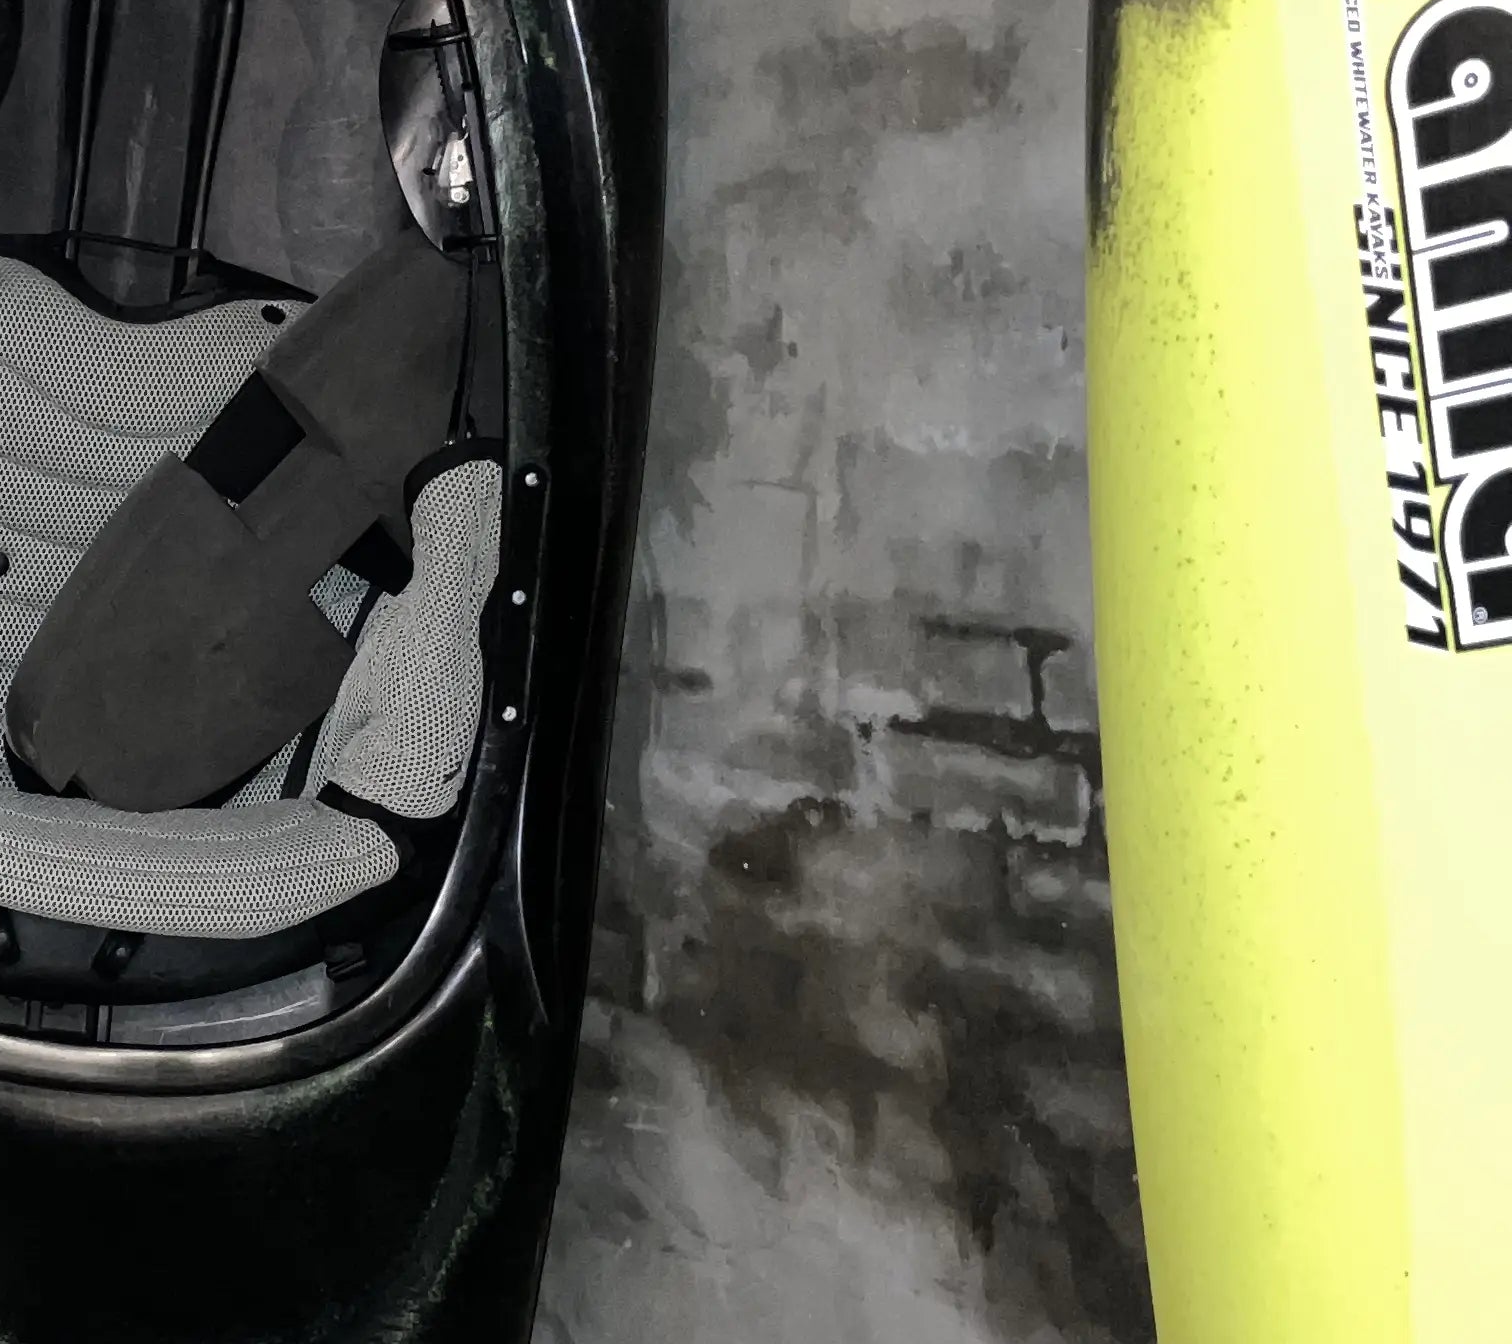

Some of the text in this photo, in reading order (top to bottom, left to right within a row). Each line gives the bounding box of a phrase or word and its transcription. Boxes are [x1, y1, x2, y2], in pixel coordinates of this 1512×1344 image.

[1349, 40, 1378, 185] WHITEWATER
[1366, 192, 1389, 280] KAYAKS
[1387, 461, 1449, 652] 1971
